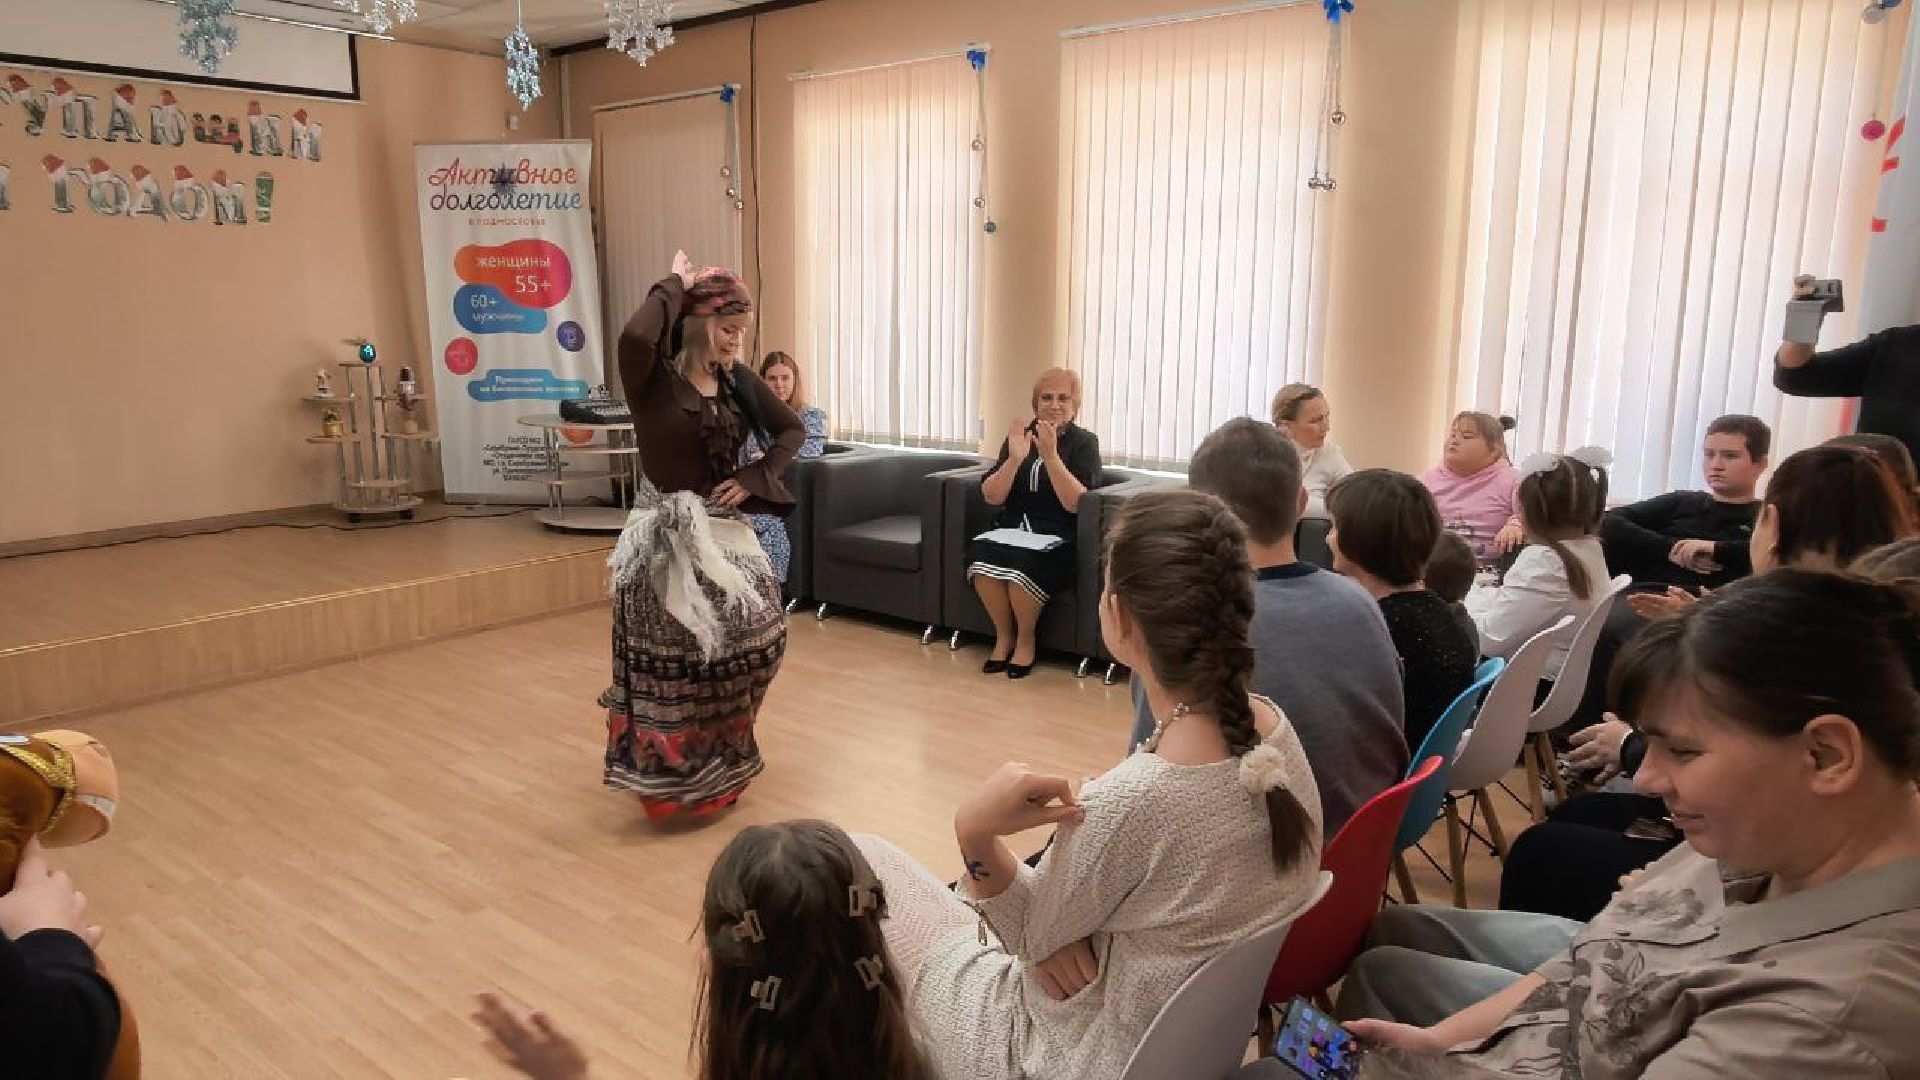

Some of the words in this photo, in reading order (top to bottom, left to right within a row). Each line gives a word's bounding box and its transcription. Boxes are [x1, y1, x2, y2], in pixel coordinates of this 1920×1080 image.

[42, 154, 274, 226] ГОДОМ!
[430, 185, 582, 210] долголетие
[476, 256, 551, 268] женщины
[515, 275, 552, 293] 55+
[471, 294, 499, 308] 60+
